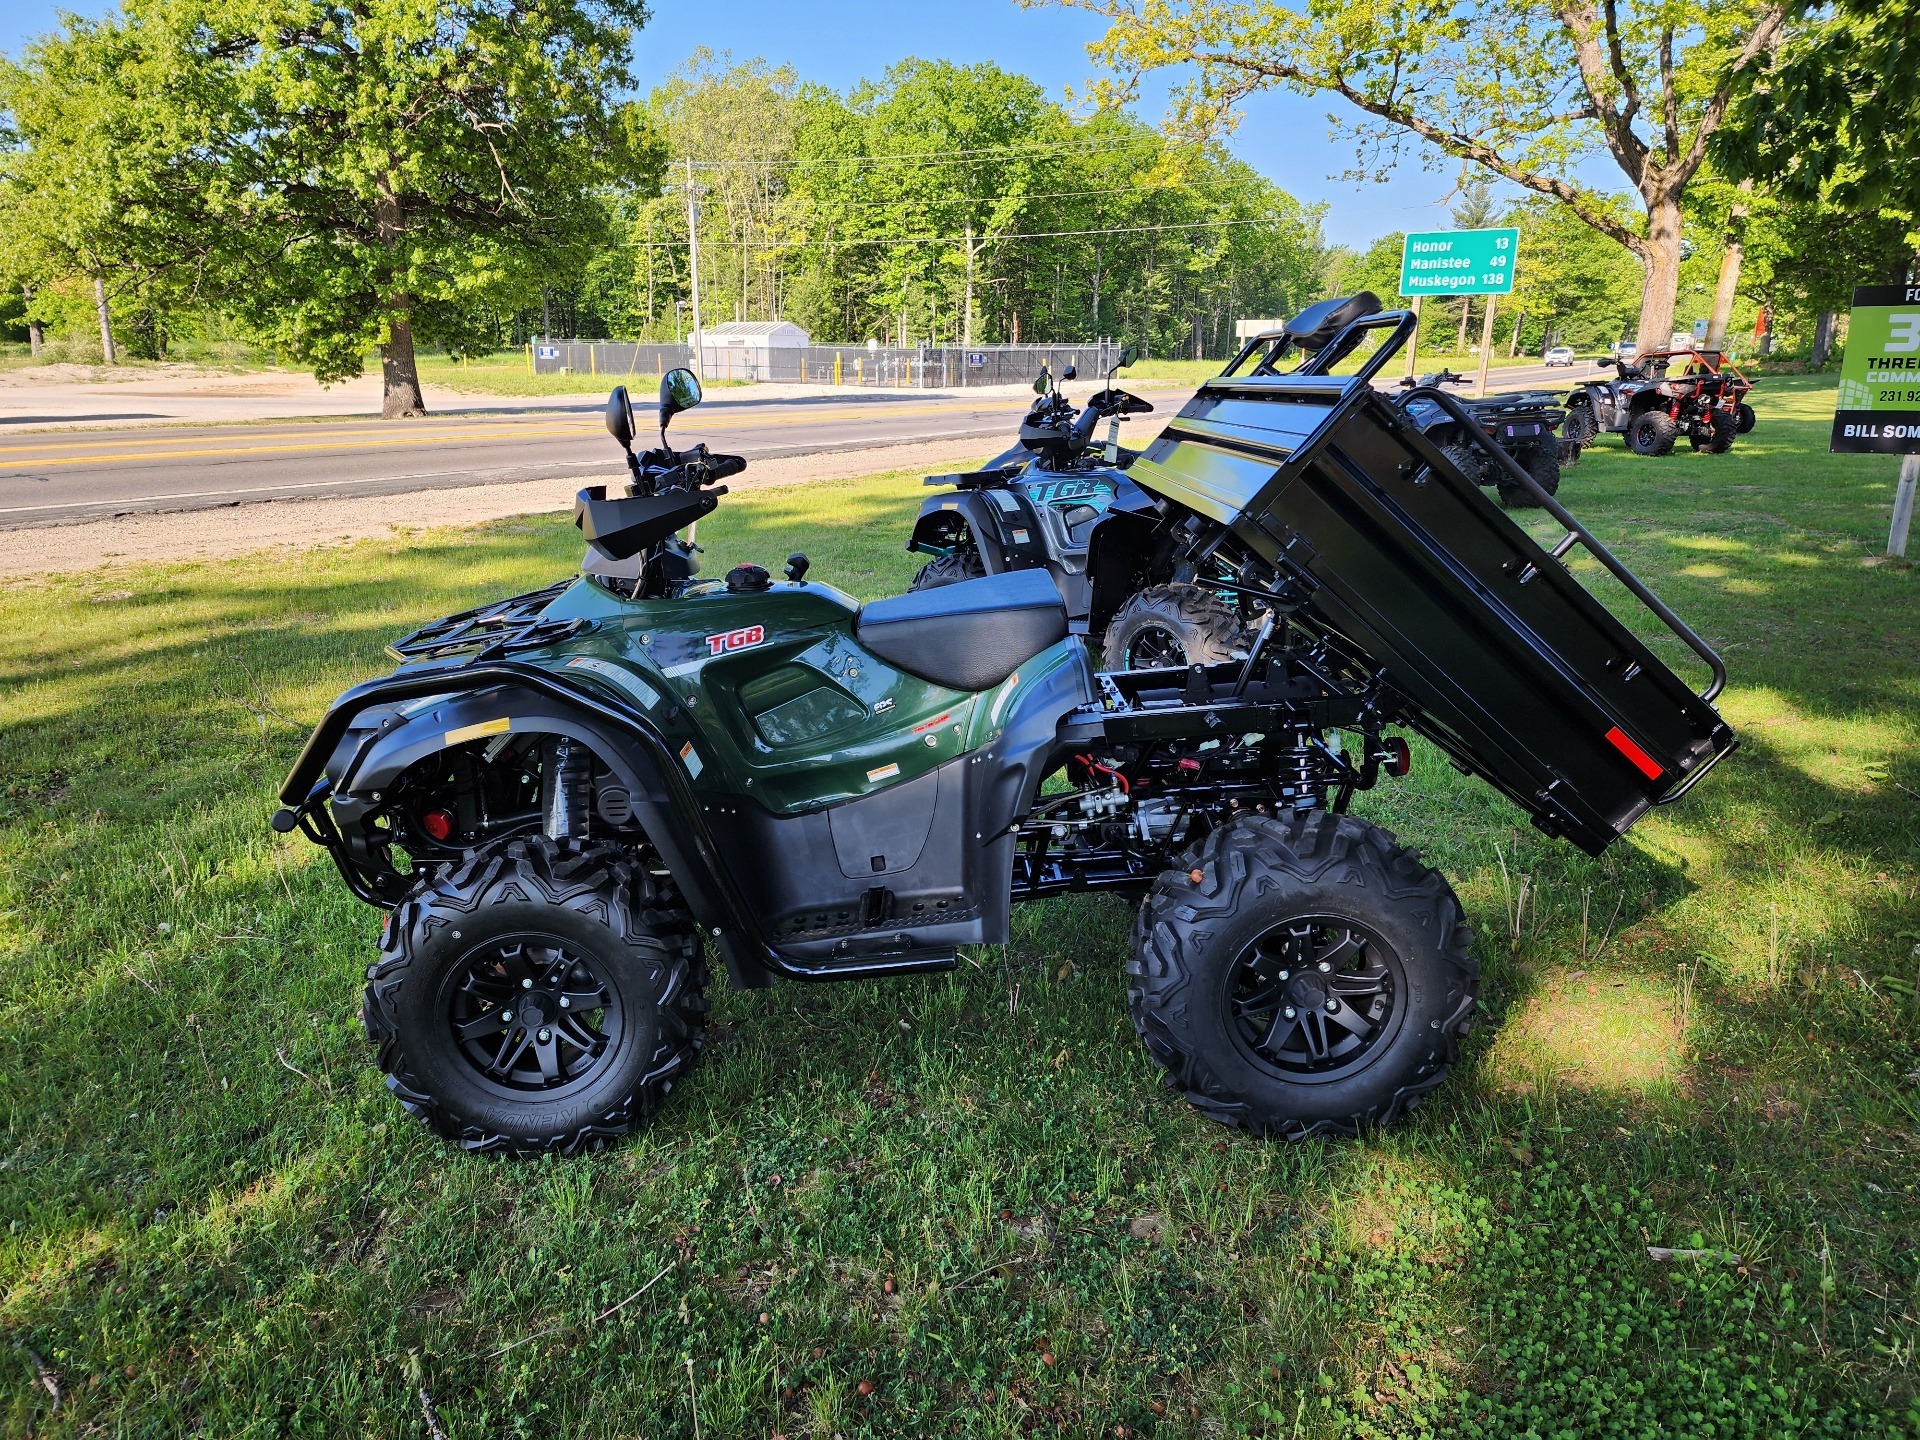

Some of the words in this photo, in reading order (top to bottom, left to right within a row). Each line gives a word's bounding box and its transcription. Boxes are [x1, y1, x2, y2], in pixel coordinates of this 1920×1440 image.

[1412, 241, 1453, 253] Honor
[1495, 237, 1509, 250] 13
[1410, 257, 1471, 270] Manistee
[1489, 255, 1507, 267] 49
[1408, 274, 1476, 289] Muskegon
[1481, 273, 1505, 285] 138
[1867, 357, 1920, 369] THRE
[1843, 424, 1879, 438] BILL
[1882, 424, 1920, 439] SOM
[1036, 479, 1100, 502] TGB
[705, 624, 765, 656] TGB
[481, 1106, 579, 1133] KENDA
